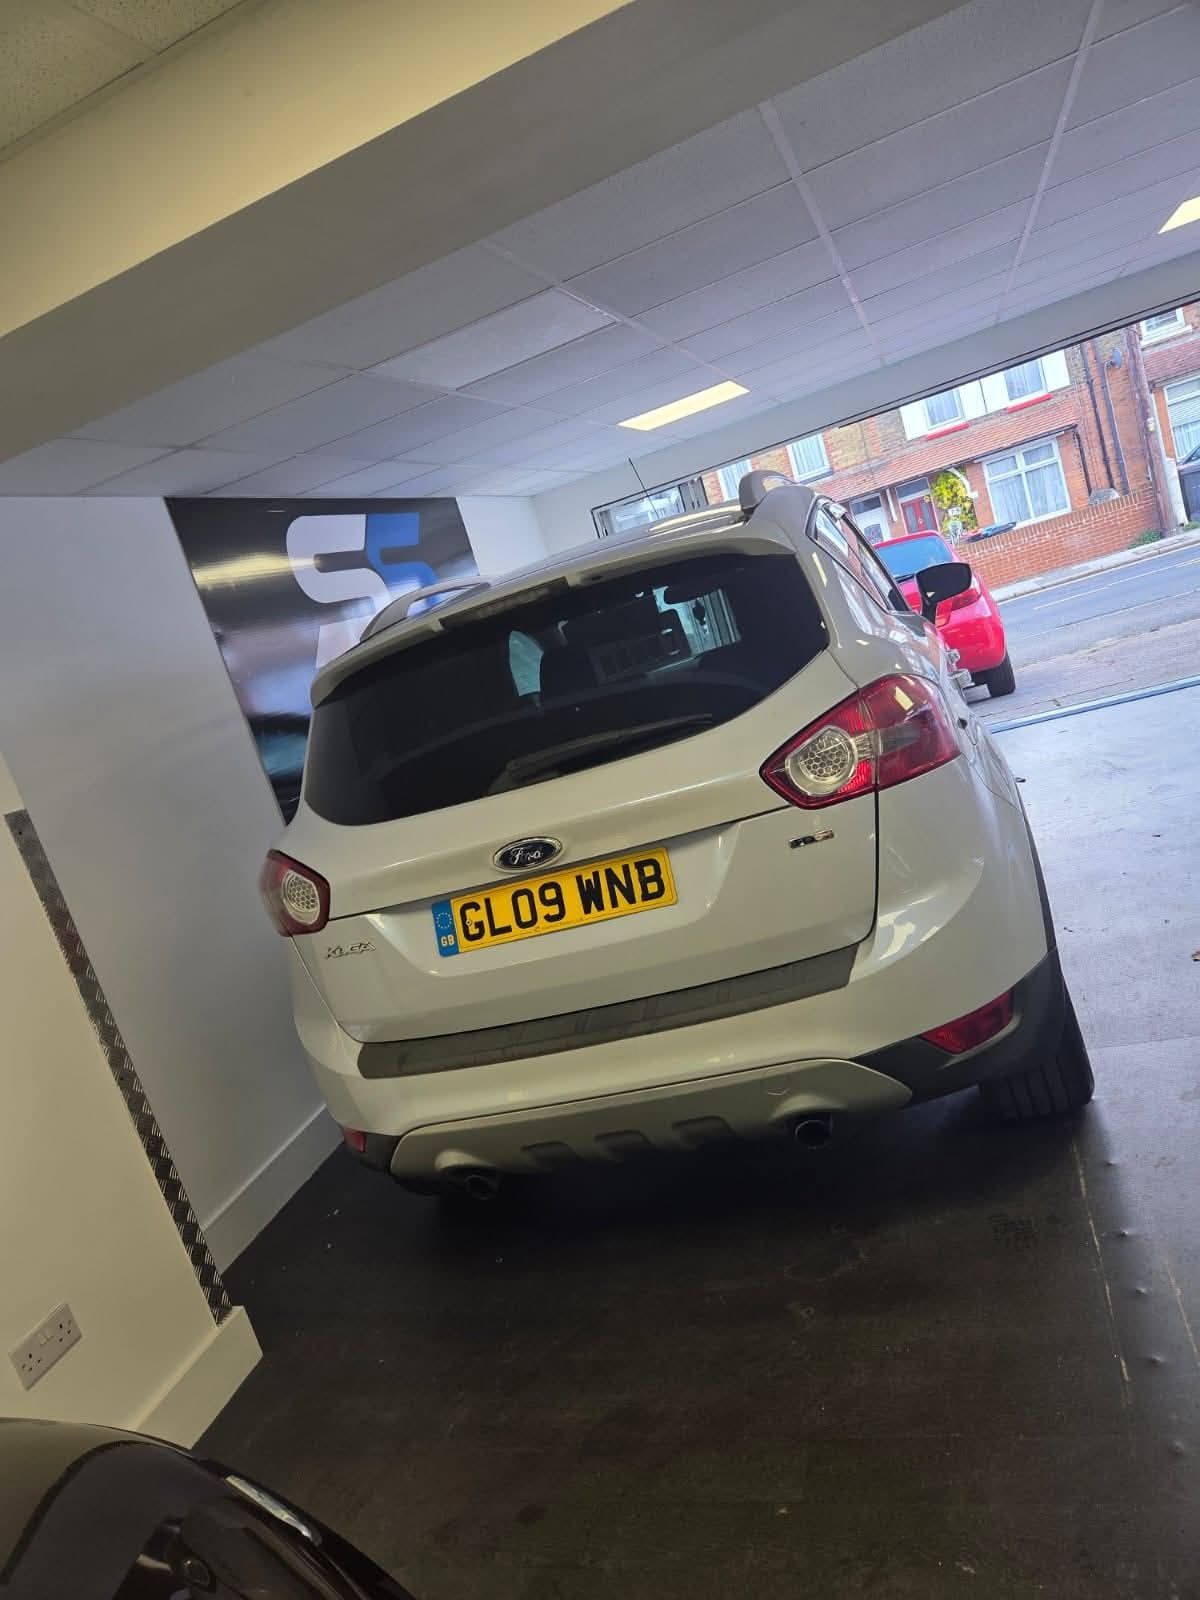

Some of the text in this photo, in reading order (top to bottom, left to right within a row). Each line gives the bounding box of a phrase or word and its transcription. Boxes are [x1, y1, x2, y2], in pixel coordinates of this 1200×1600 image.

[459, 857, 666, 942] GL09 WNB
[440, 934, 455, 948] GB
